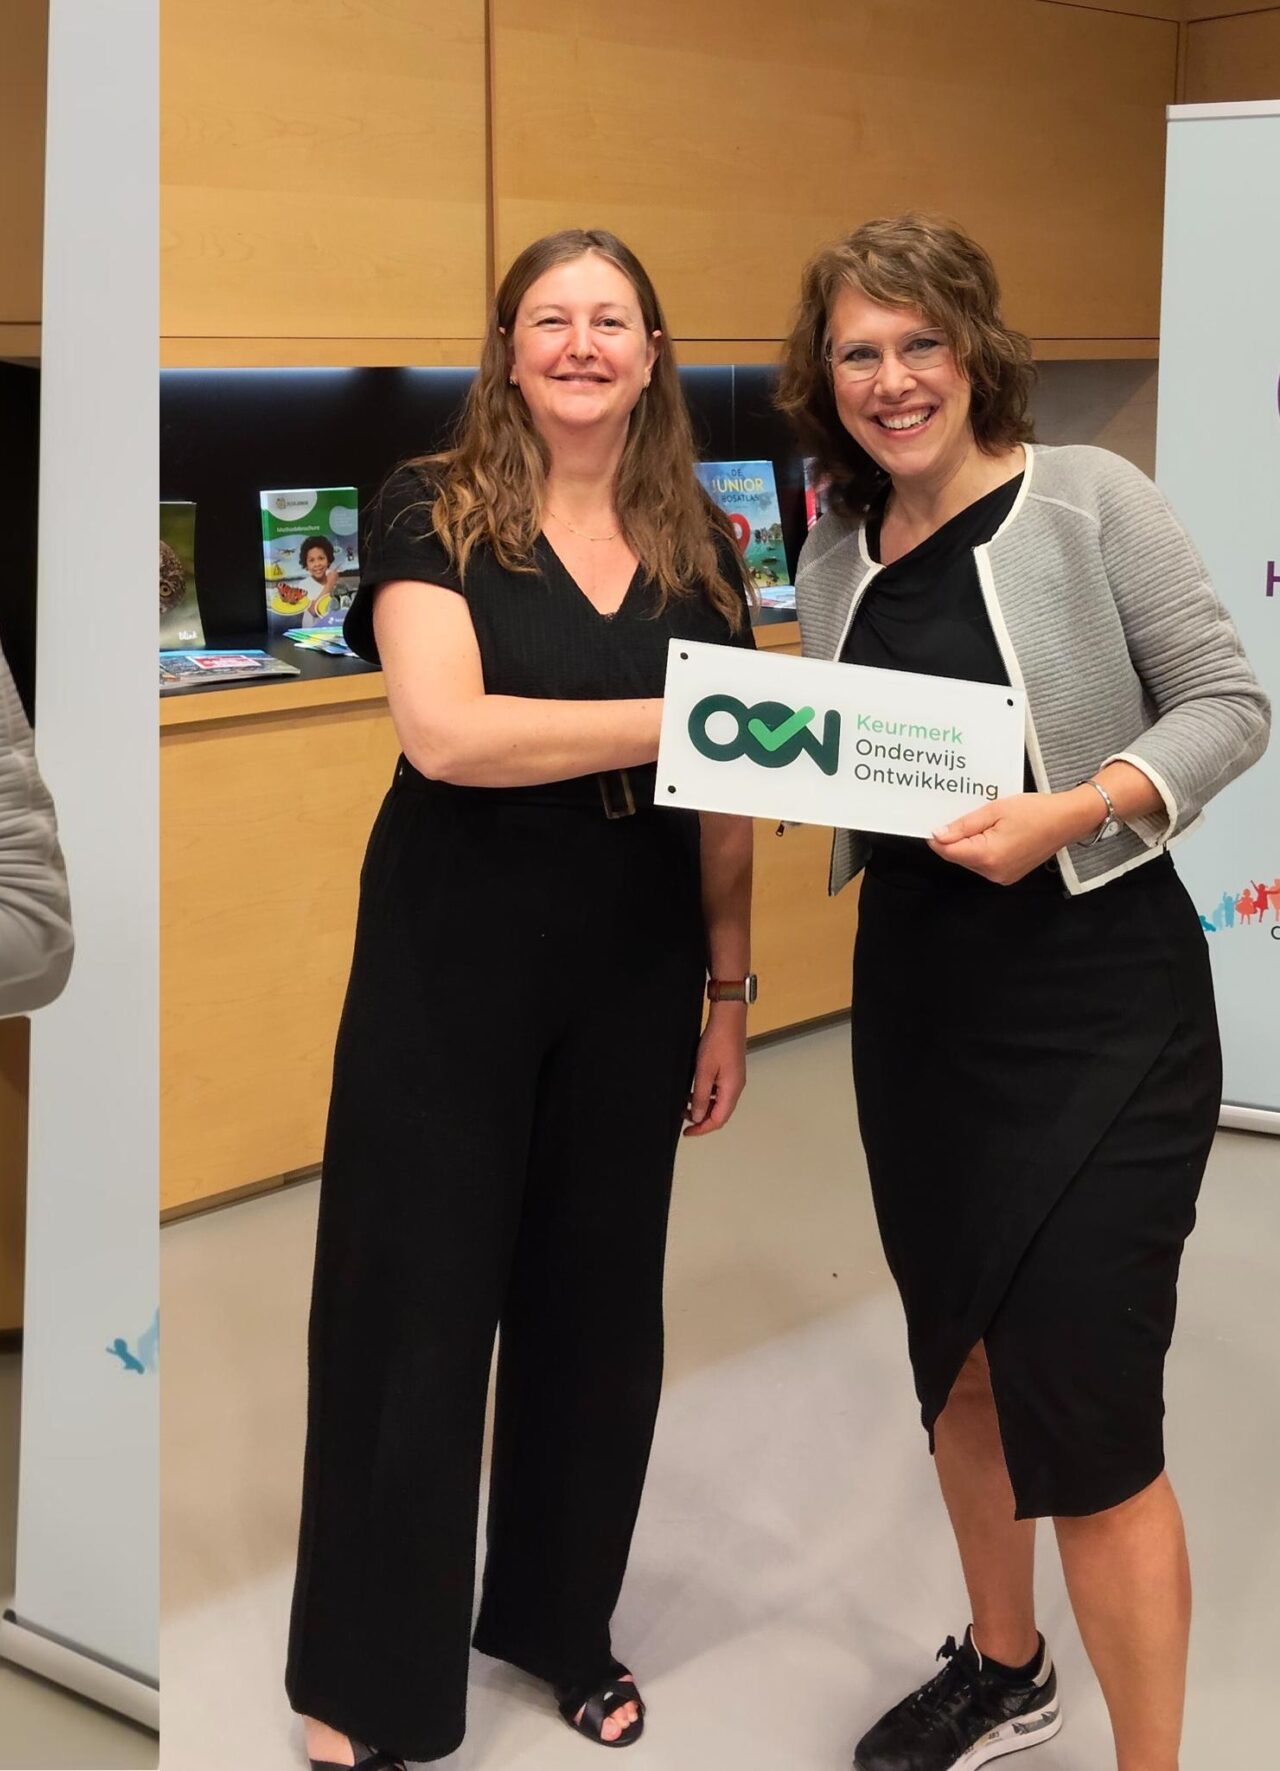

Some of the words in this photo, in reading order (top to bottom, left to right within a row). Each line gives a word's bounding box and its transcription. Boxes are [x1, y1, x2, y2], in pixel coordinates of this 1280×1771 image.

[712, 478, 763, 493] JUNIOR
[730, 468, 743, 478] DE
[857, 714, 963, 744] Keurmerk
[856, 739, 967, 770] Onderwijs
[855, 764, 1000, 800] Ontwikkeling
